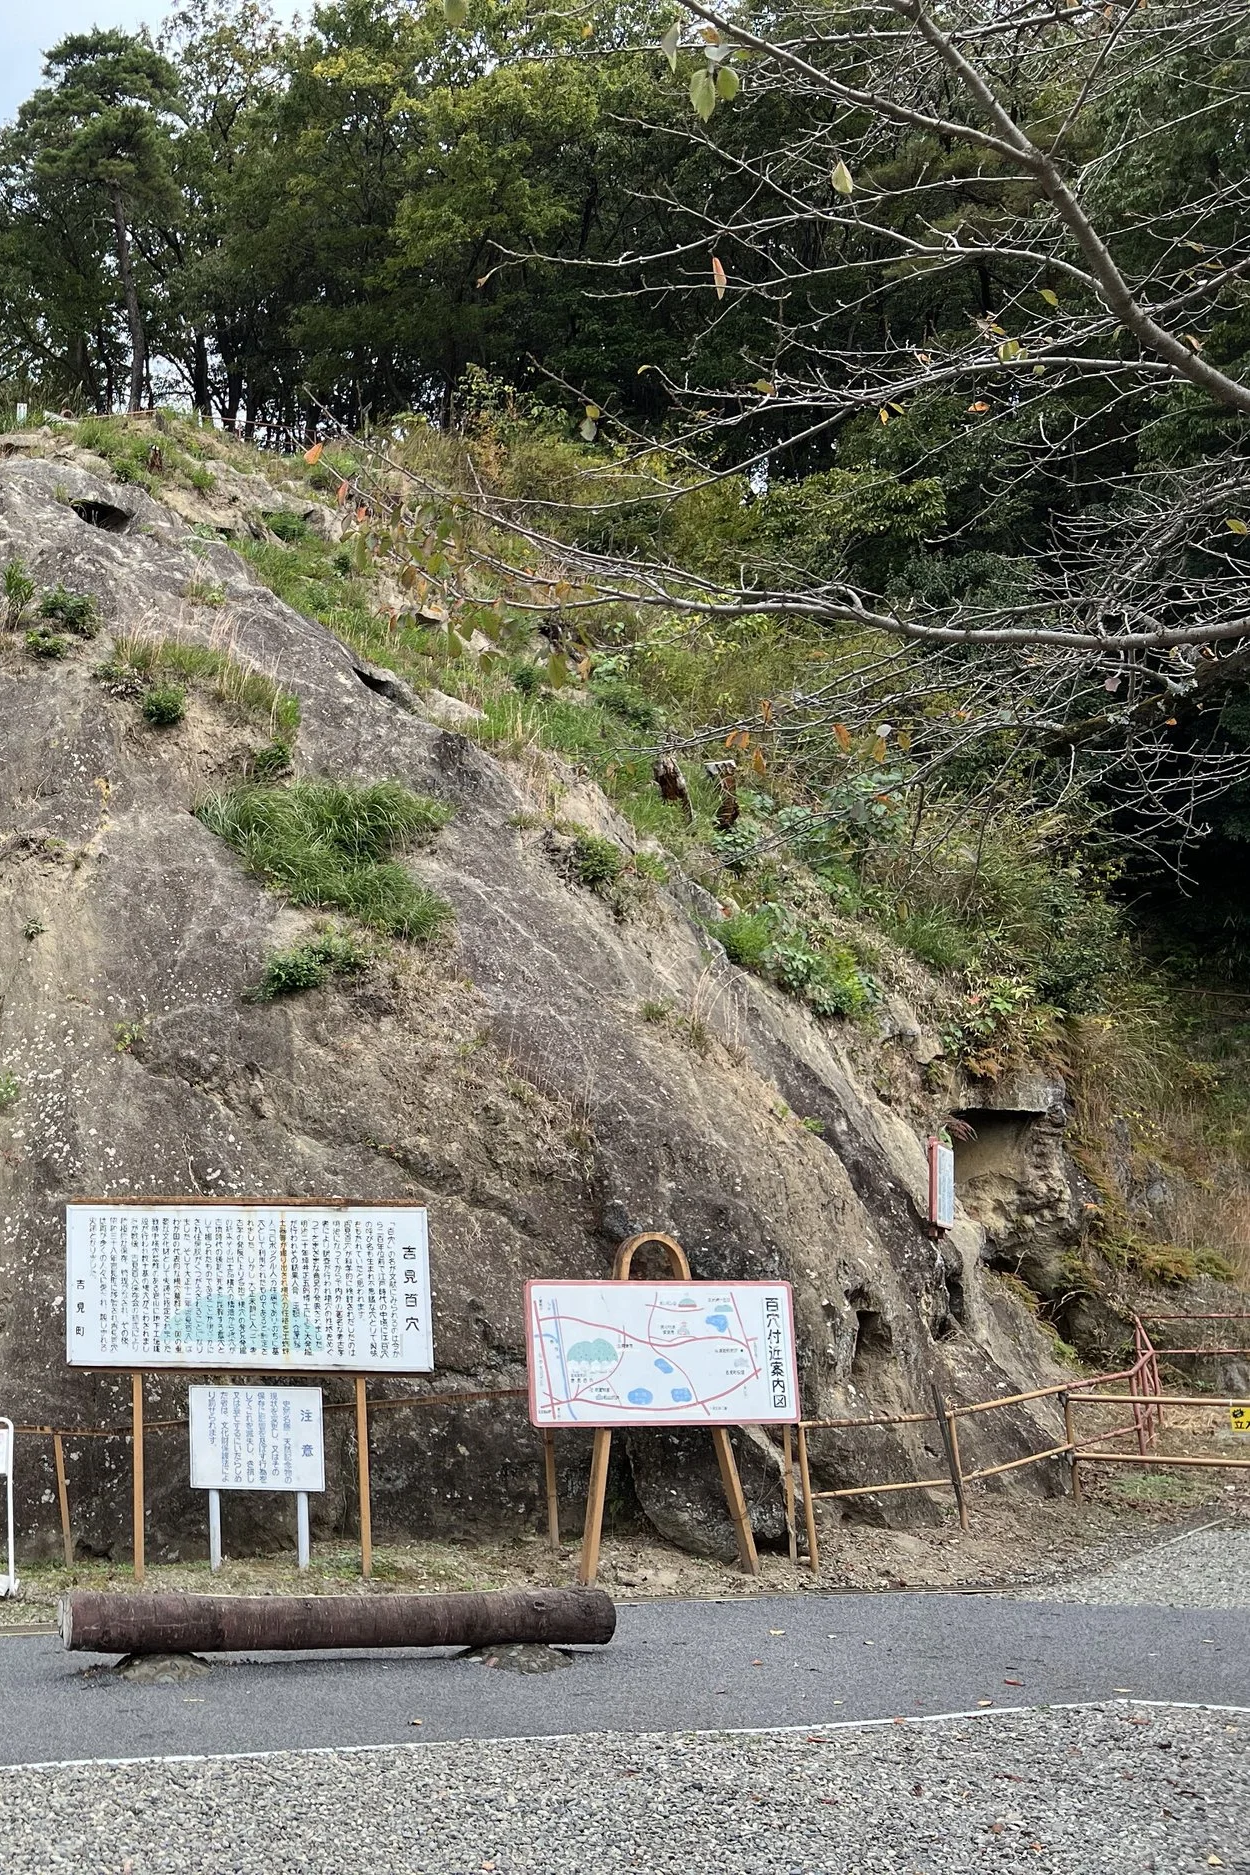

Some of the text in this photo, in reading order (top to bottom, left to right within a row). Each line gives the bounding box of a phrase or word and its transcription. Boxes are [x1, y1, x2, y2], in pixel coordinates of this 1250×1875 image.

[75, 1279, 85, 1336] 吉見町
[402, 1246, 420, 1331] 吉見百穴
[764, 1297, 787, 1408] 百穴付近案内図
[300, 1409, 314, 1458] 注意
